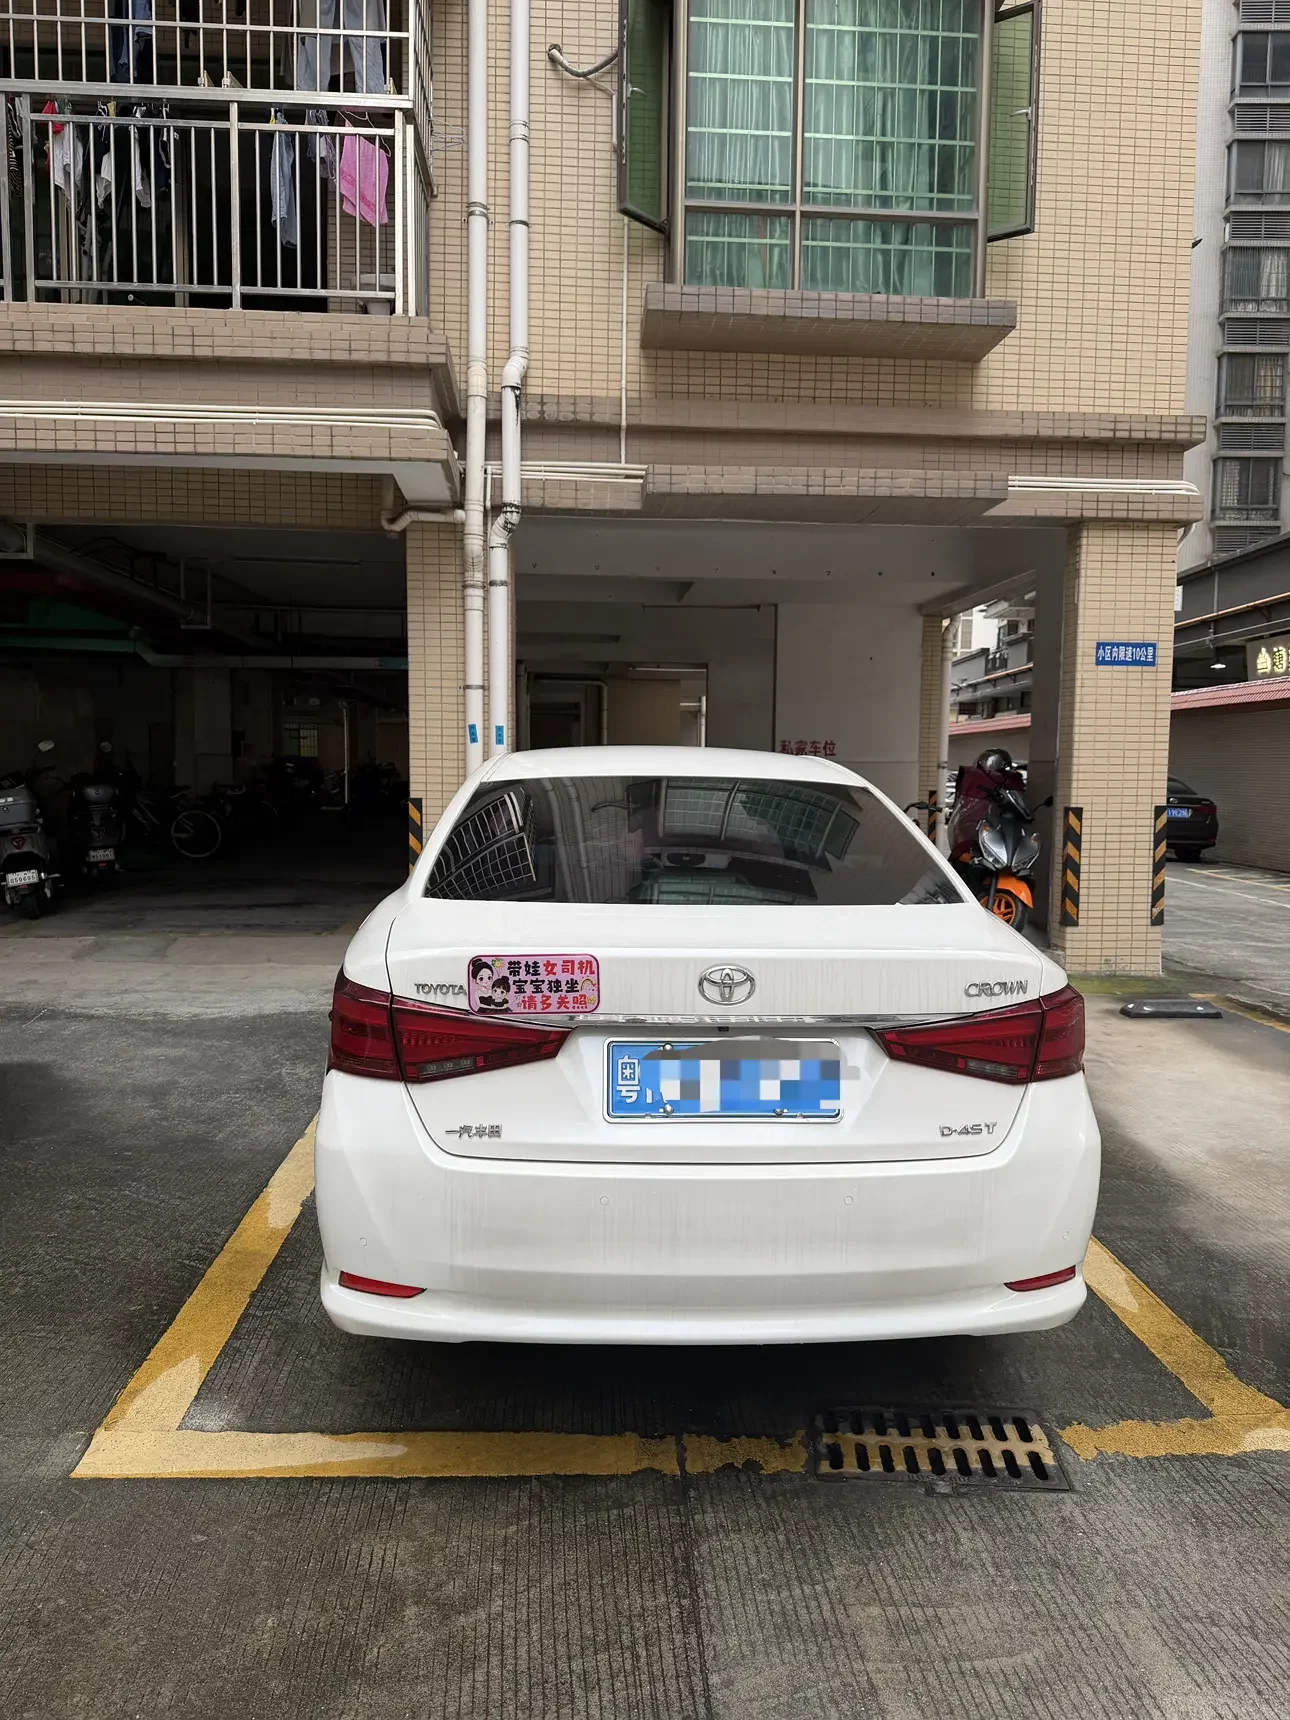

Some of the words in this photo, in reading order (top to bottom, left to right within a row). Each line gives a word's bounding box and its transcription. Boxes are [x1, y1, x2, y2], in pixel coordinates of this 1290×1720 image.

[1097, 645, 1154, 661] 小区内限速10公里
[780, 740, 836, 757] 私家车位
[507, 960, 595, 977] 带娃女司机
[414, 983, 467, 996] TOYOTA
[512, 978, 580, 994] 宝宝独坐
[965, 980, 1028, 997] CROWN
[521, 994, 588, 1011] 请多关照
